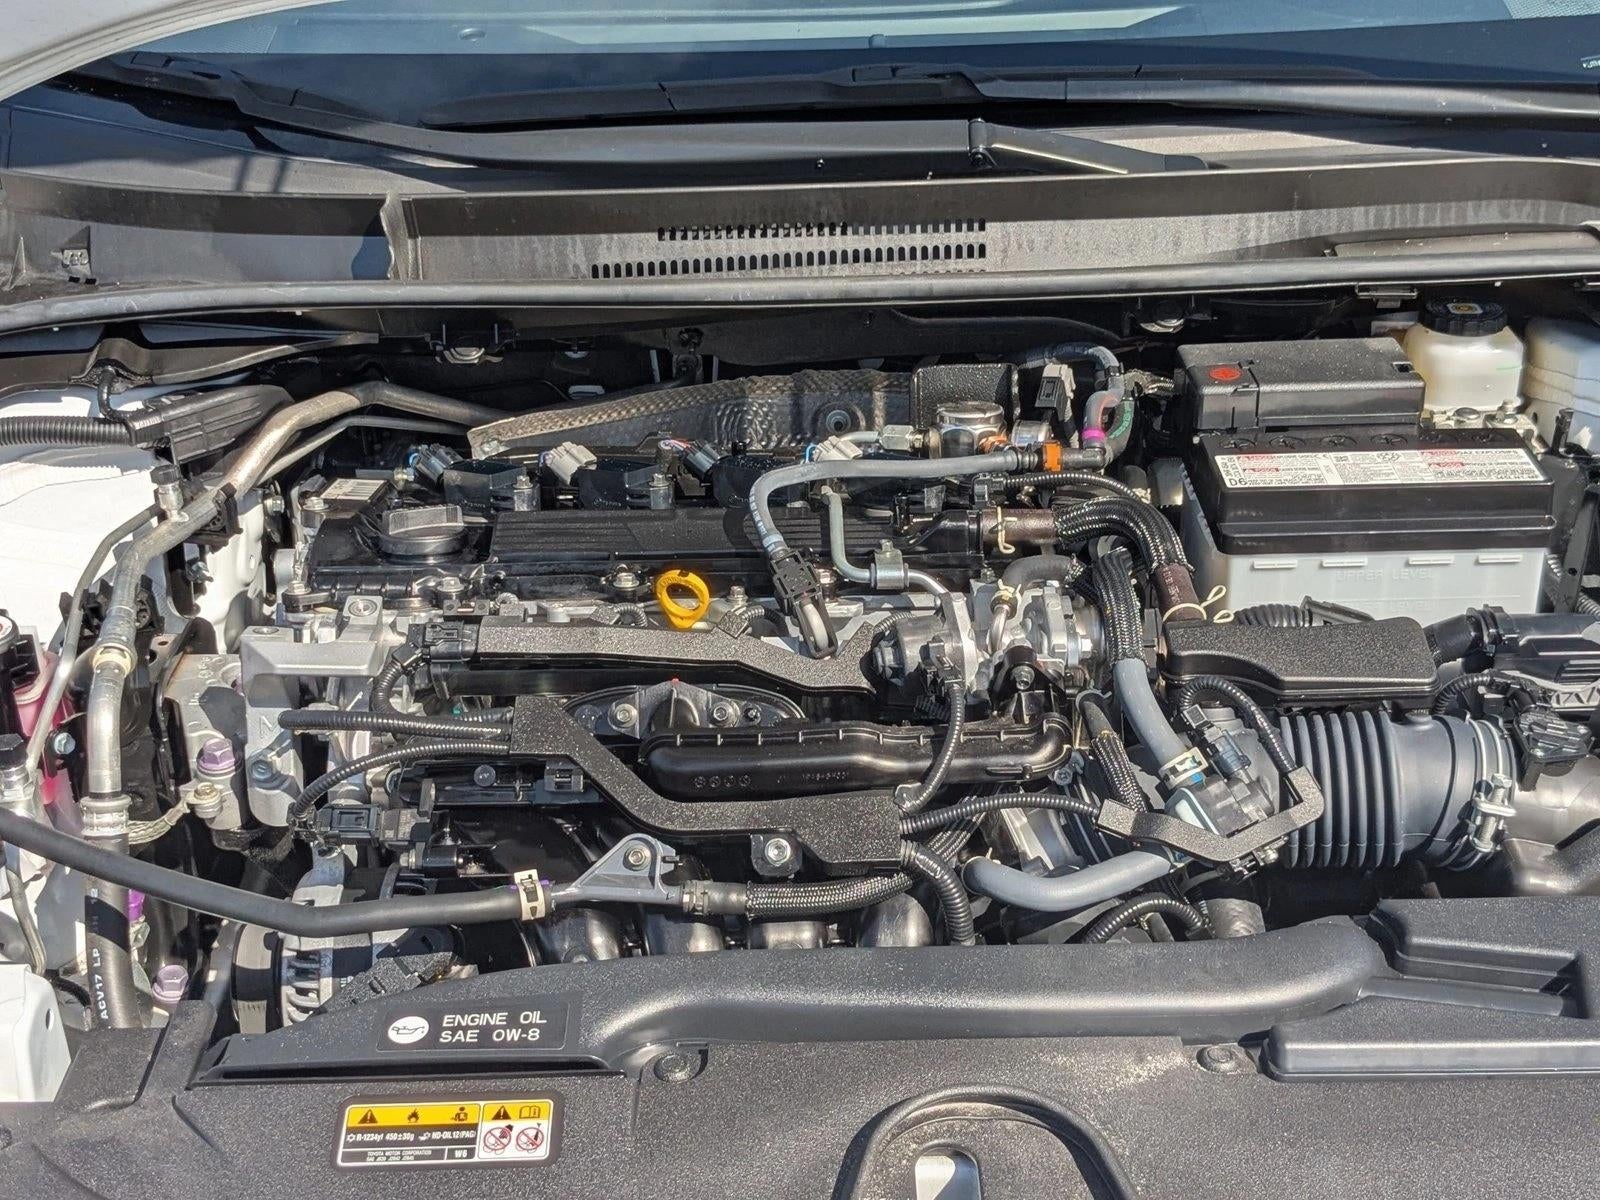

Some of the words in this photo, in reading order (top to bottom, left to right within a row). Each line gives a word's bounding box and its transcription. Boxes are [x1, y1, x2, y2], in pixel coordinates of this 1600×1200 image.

[92, 947, 101, 968] LP
[94, 974, 109, 1020] ACV17
[442, 1012, 508, 1027] ENGINE
[520, 1010, 548, 1024] OIL
[439, 1029, 480, 1043] SAE
